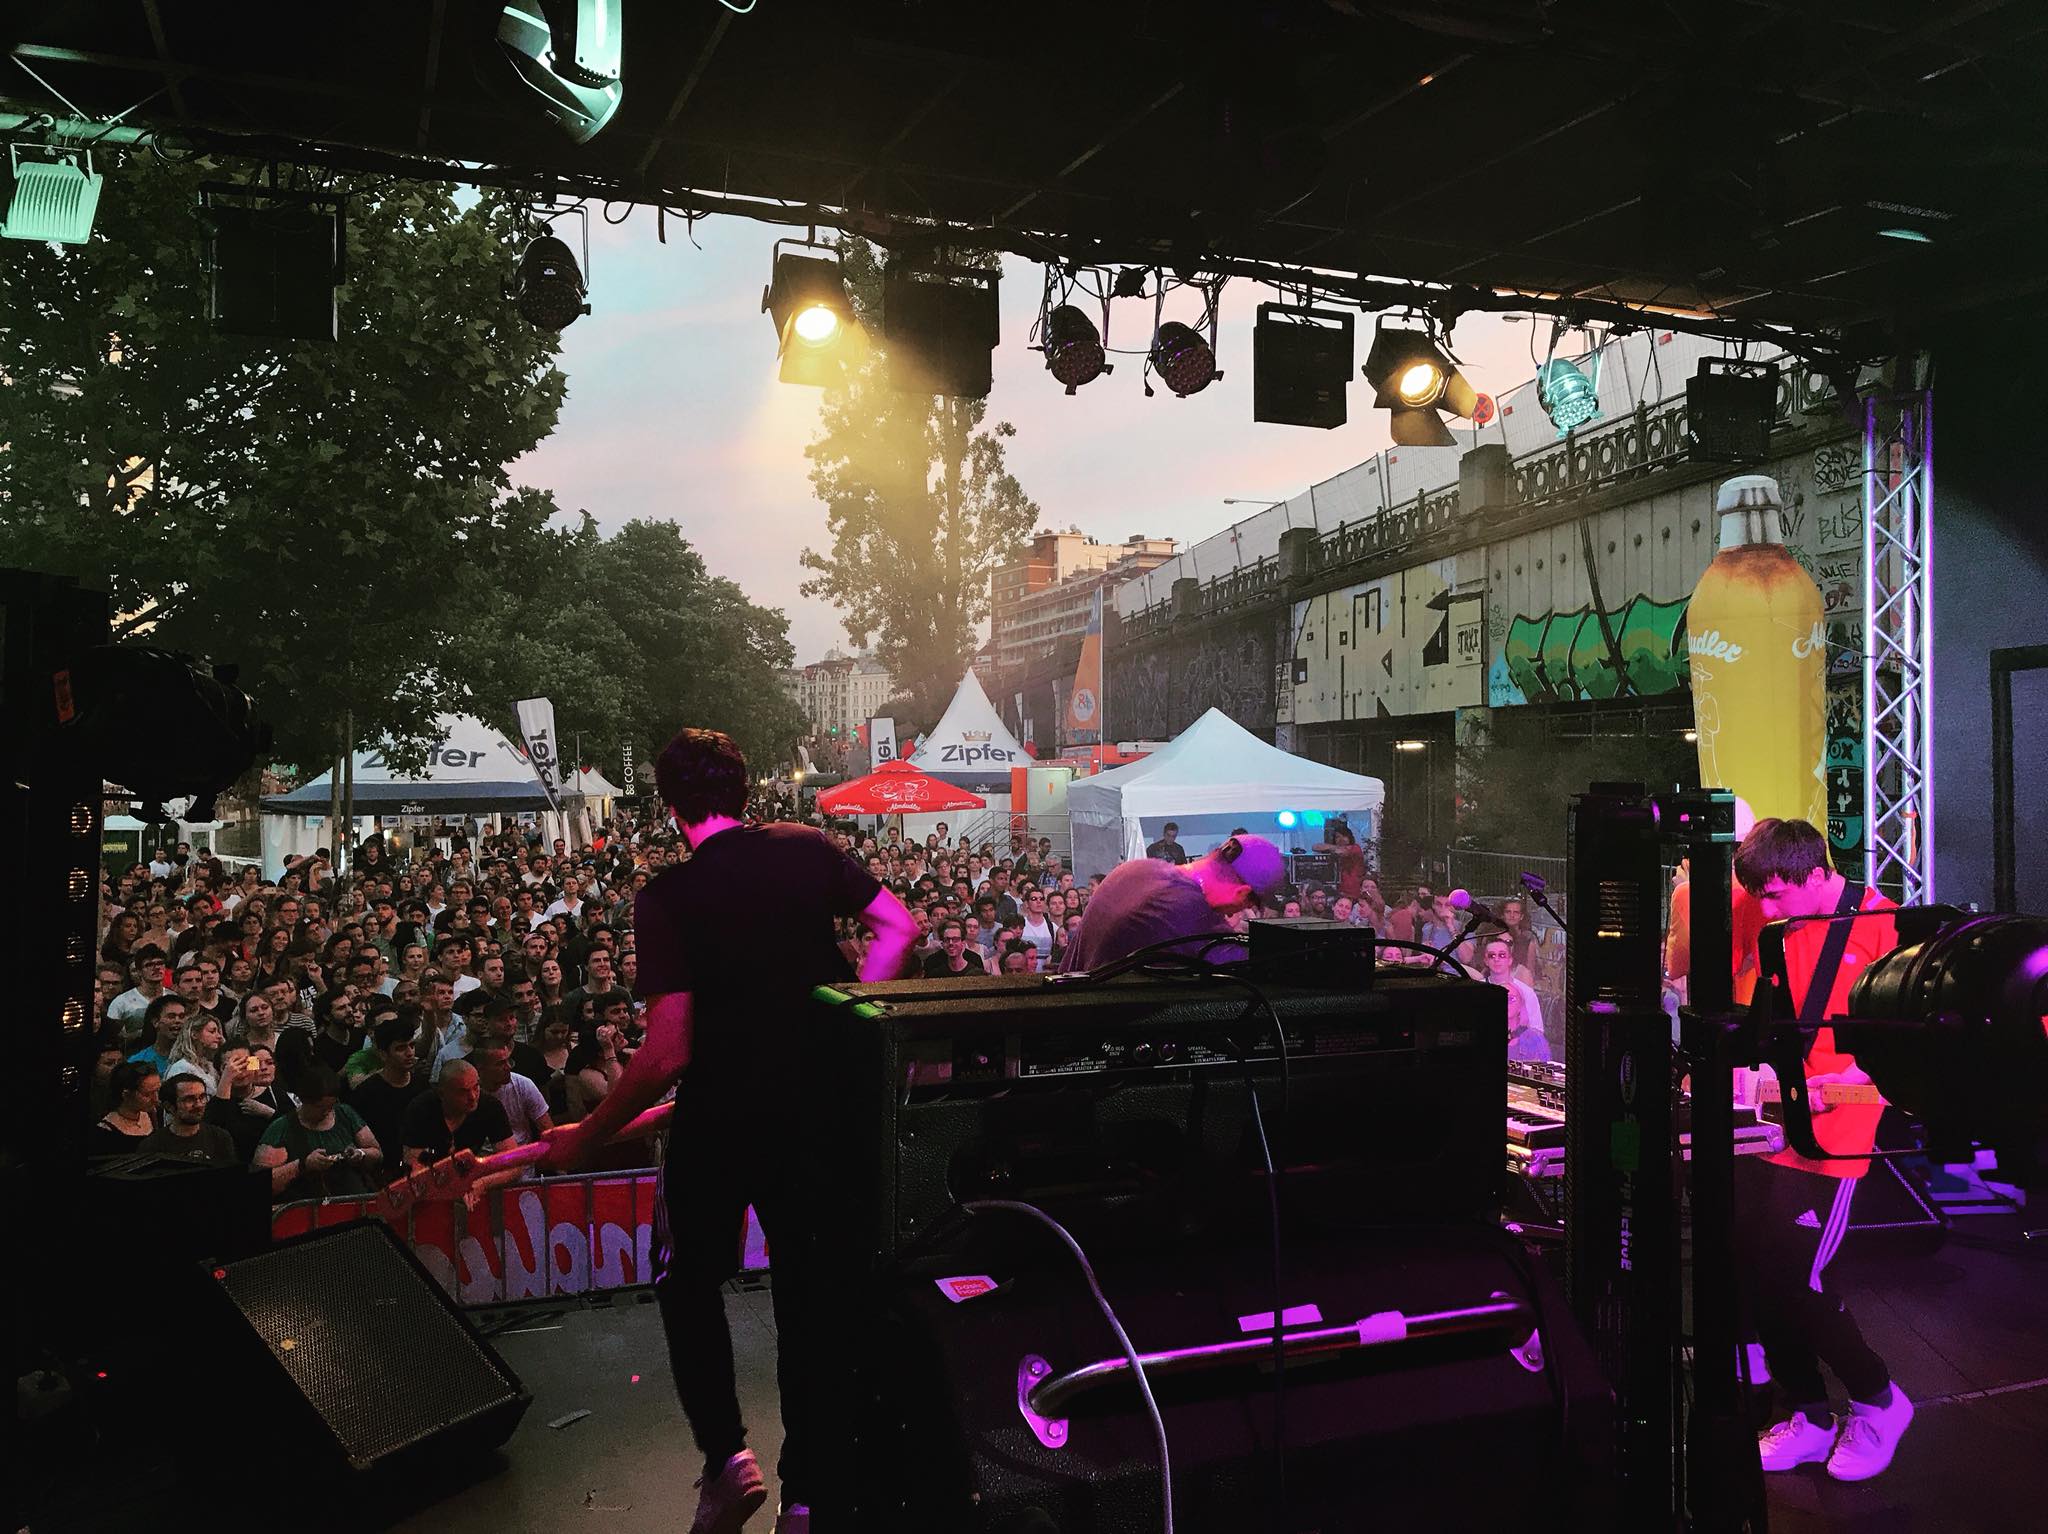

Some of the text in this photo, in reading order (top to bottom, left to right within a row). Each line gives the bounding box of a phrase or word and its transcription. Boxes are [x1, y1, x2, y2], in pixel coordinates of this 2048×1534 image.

[361, 740, 486, 769] Zfer
[623, 746, 634, 783] COFFEE
[941, 744, 1016, 766] Zipfer
[401, 804, 424, 814] Zipfer
